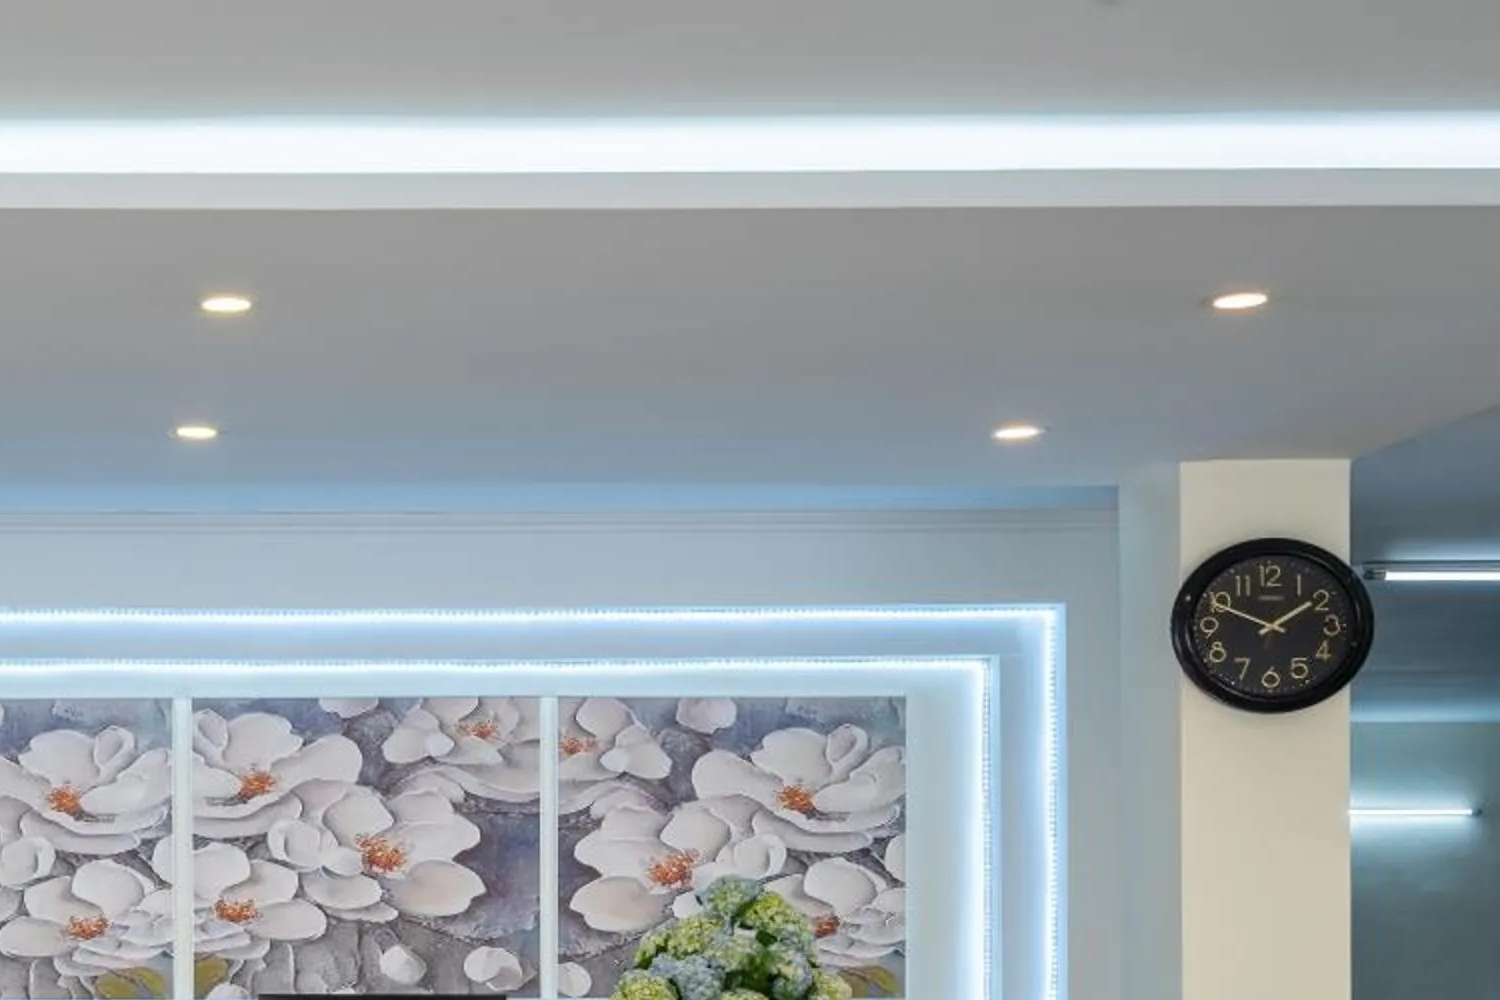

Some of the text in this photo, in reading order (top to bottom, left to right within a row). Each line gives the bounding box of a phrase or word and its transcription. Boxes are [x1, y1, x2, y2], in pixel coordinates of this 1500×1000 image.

[1235, 575, 1251, 597] 11
[1259, 565, 1282, 588] 12
[1296, 574, 1302, 596] 1
[1312, 589, 1331, 611] 2
[1200, 617, 1219, 639] 9
[1323, 613, 1341, 636] 3
[1209, 641, 1228, 663] 8
[1315, 640, 1332, 661] 4
[1234, 657, 1251, 680] 7
[1261, 666, 1281, 688] 6
[1291, 657, 1309, 679] 5
